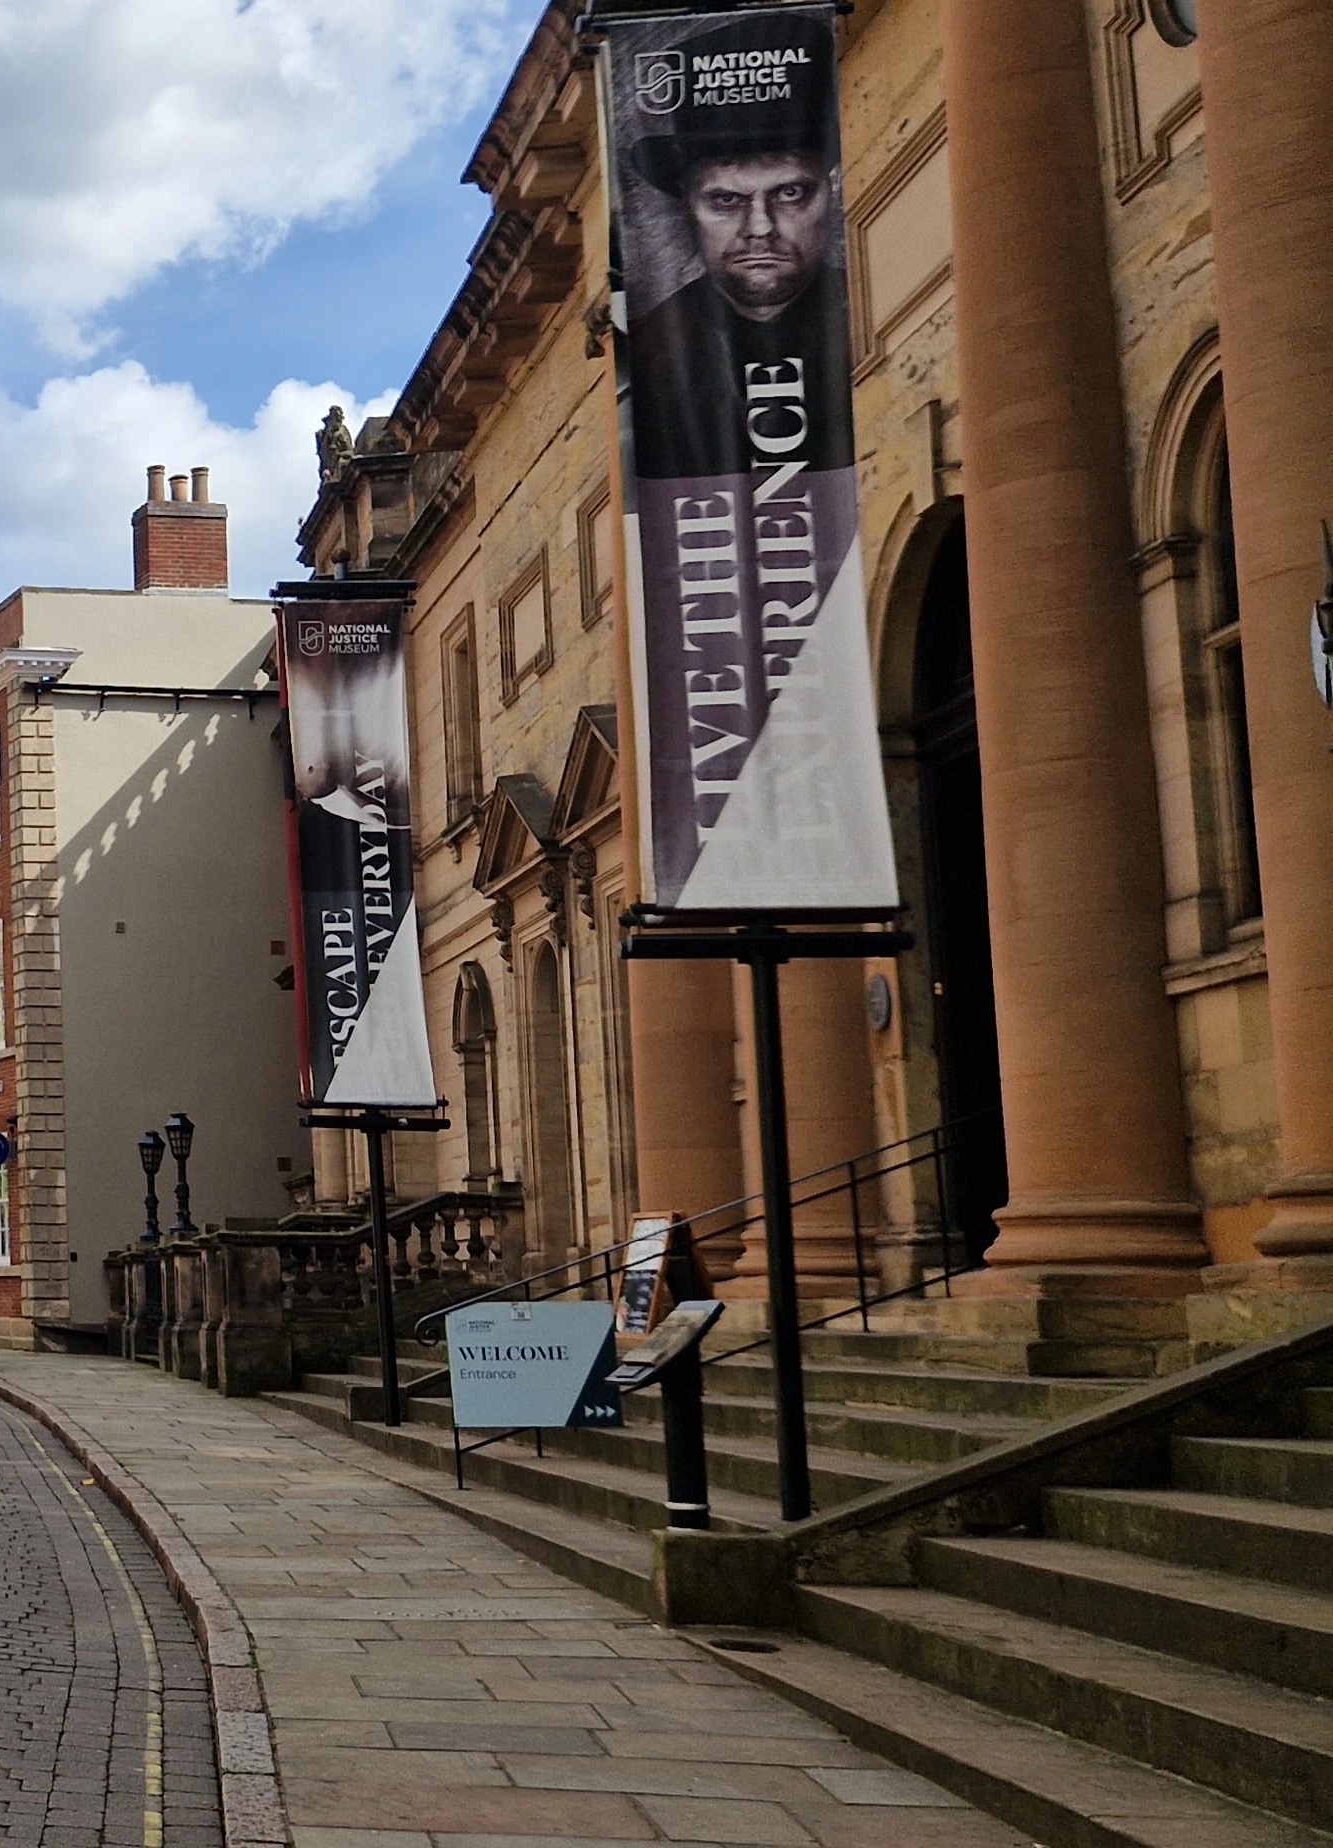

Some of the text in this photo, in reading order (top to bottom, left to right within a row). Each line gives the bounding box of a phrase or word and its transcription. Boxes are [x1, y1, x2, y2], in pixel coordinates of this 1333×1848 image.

[692, 47, 812, 72] NATIONAL
[693, 66, 787, 89] JUSTICE
[693, 83, 792, 107] MUSEUM
[674, 490, 743, 653] THE
[328, 624, 391, 634] NATIONAL
[328, 634, 378, 643] JUSTICE
[328, 644, 380, 654] MUSEUM
[458, 1346, 570, 1361] WELCOME
[460, 1368, 516, 1380] Entrance
